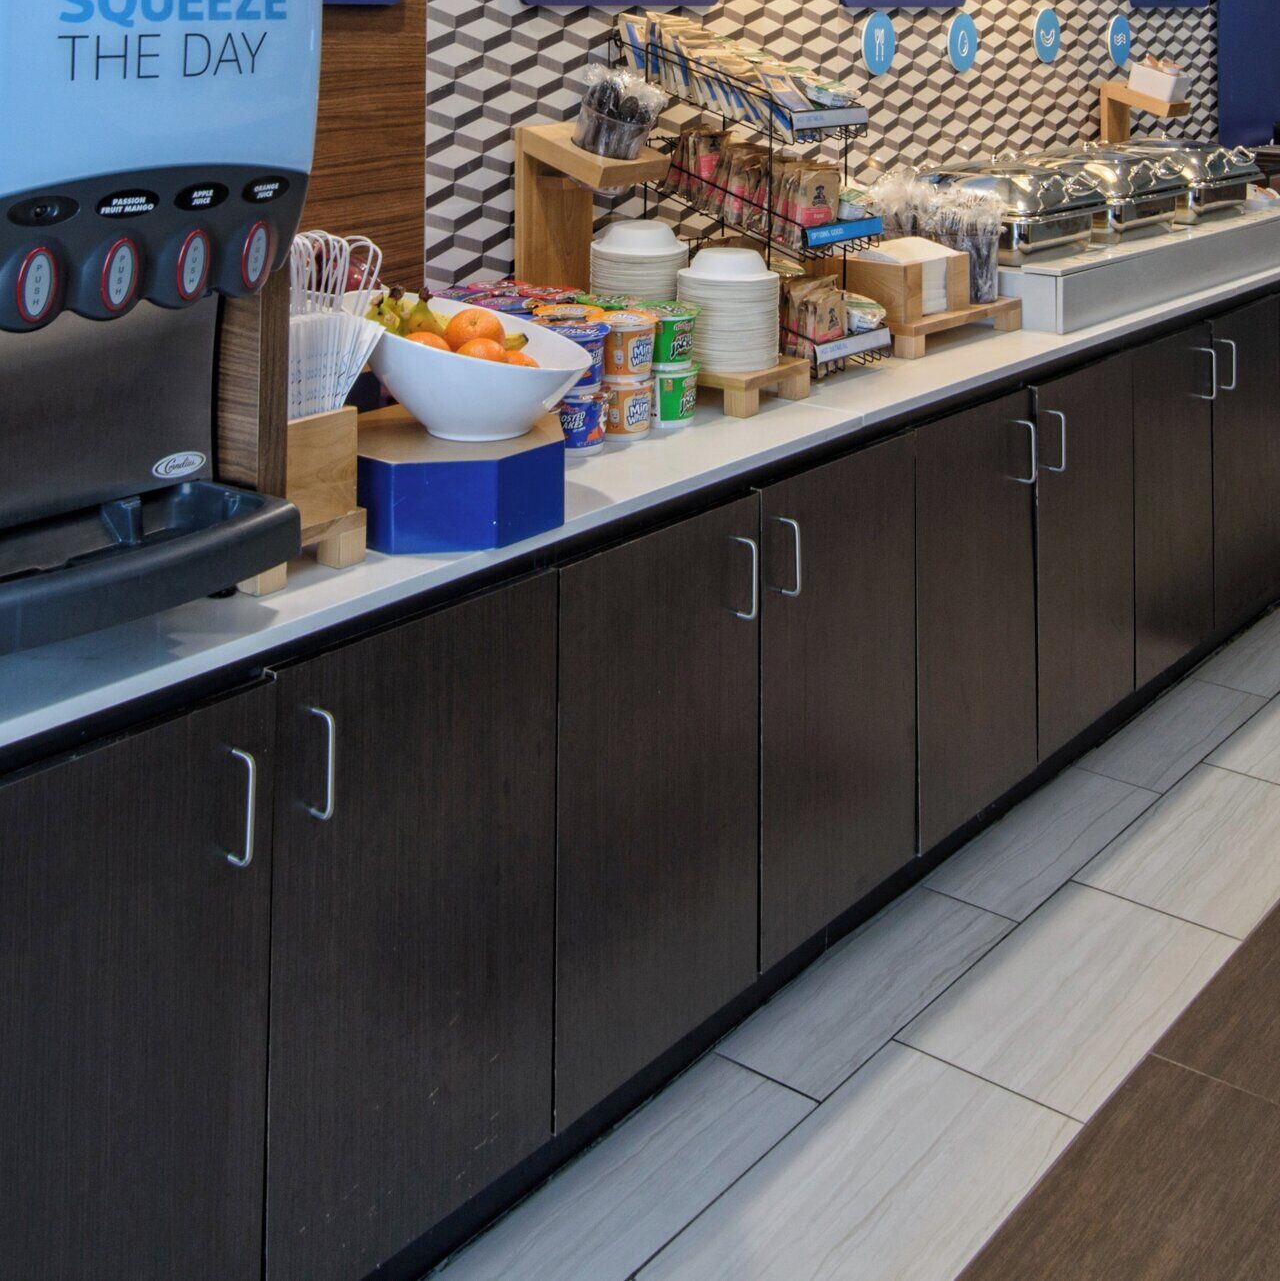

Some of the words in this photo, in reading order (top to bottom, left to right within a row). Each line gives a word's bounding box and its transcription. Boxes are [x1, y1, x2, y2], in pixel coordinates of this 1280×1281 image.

[58, 33, 161, 82] THE
[182, 31, 268, 78] DAY
[192, 189, 214, 198] APPLE
[253, 183, 280, 193] ORANGE
[256, 191, 273, 199] JUICE
[112, 196, 147, 206] PASSION
[191, 197, 211, 206] JUICE
[100, 205, 122, 215] FRUIT
[124, 203, 155, 213] MANGO
[252, 236, 262, 273] PUSH
[189, 246, 199, 285] PUSH
[115, 255, 126, 296] PUSH
[33, 264, 42, 305] PUSH
[561, 411, 586, 422] OSTED
[562, 419, 584, 429] AKES
